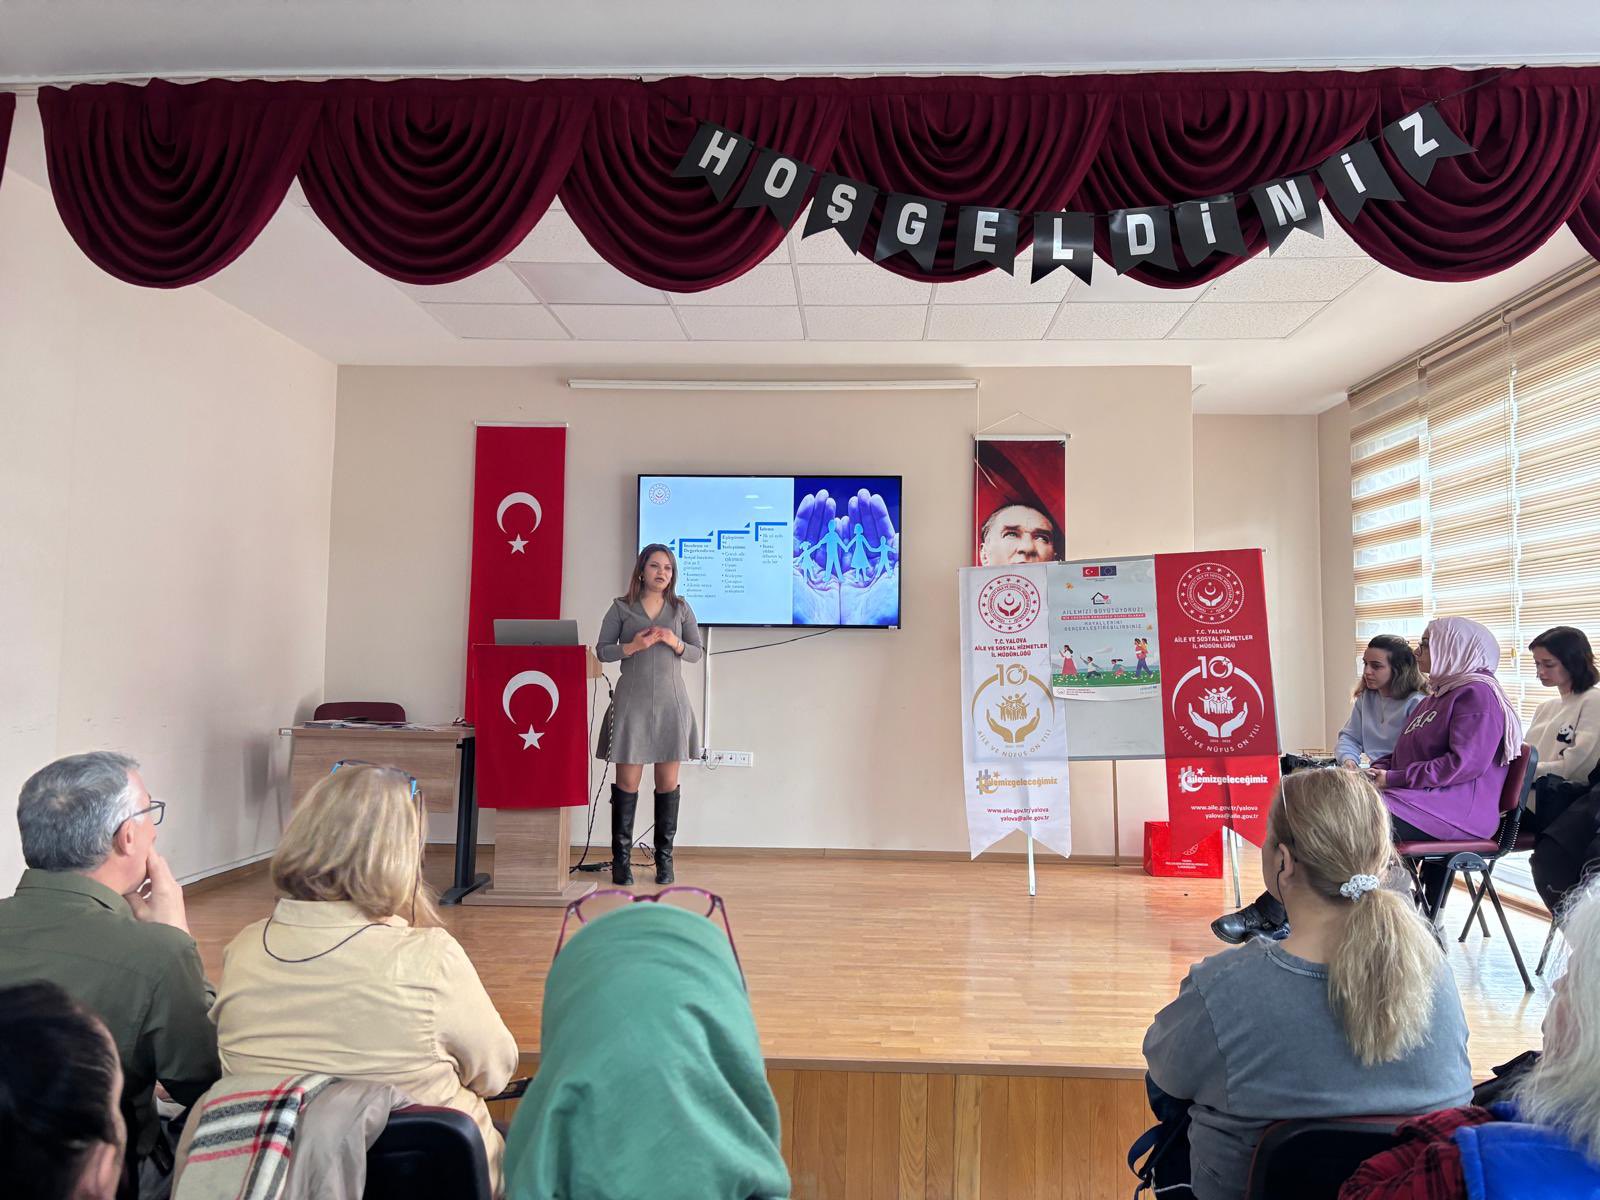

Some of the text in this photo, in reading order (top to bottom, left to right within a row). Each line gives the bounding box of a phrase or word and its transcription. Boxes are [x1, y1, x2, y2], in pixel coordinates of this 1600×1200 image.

[1179, 725, 1192, 740] AİLE
[1194, 740, 1204, 749] VE
[1238, 739, 1248, 749] ON
[1249, 724, 1260, 738] YILI
[1030, 744, 1040, 752] ON
